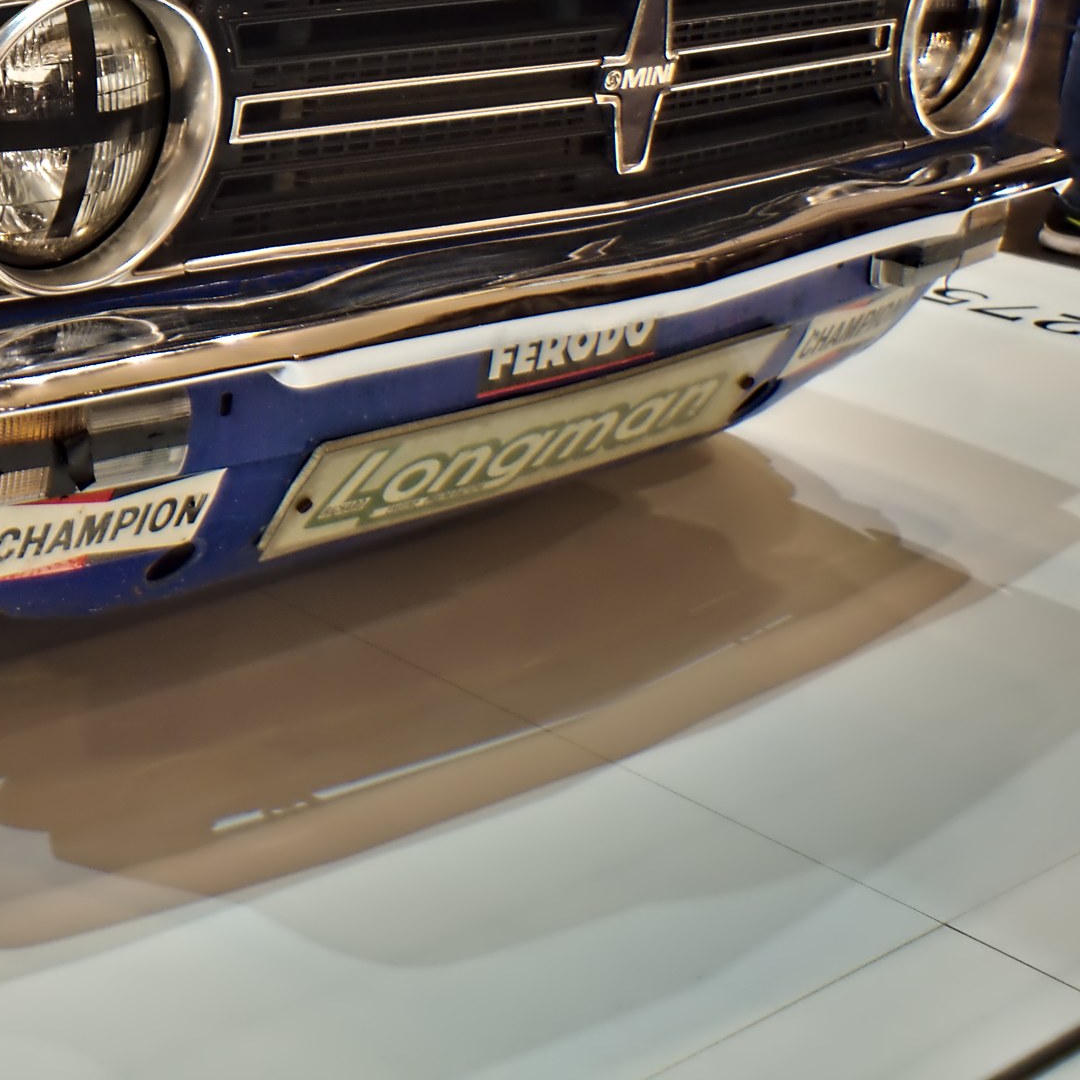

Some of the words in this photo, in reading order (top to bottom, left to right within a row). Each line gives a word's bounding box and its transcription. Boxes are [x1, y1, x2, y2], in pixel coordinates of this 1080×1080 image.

[620, 62, 676, 90] MINI
[488, 317, 656, 381] FERODO
[308, 372, 726, 527] Longman
